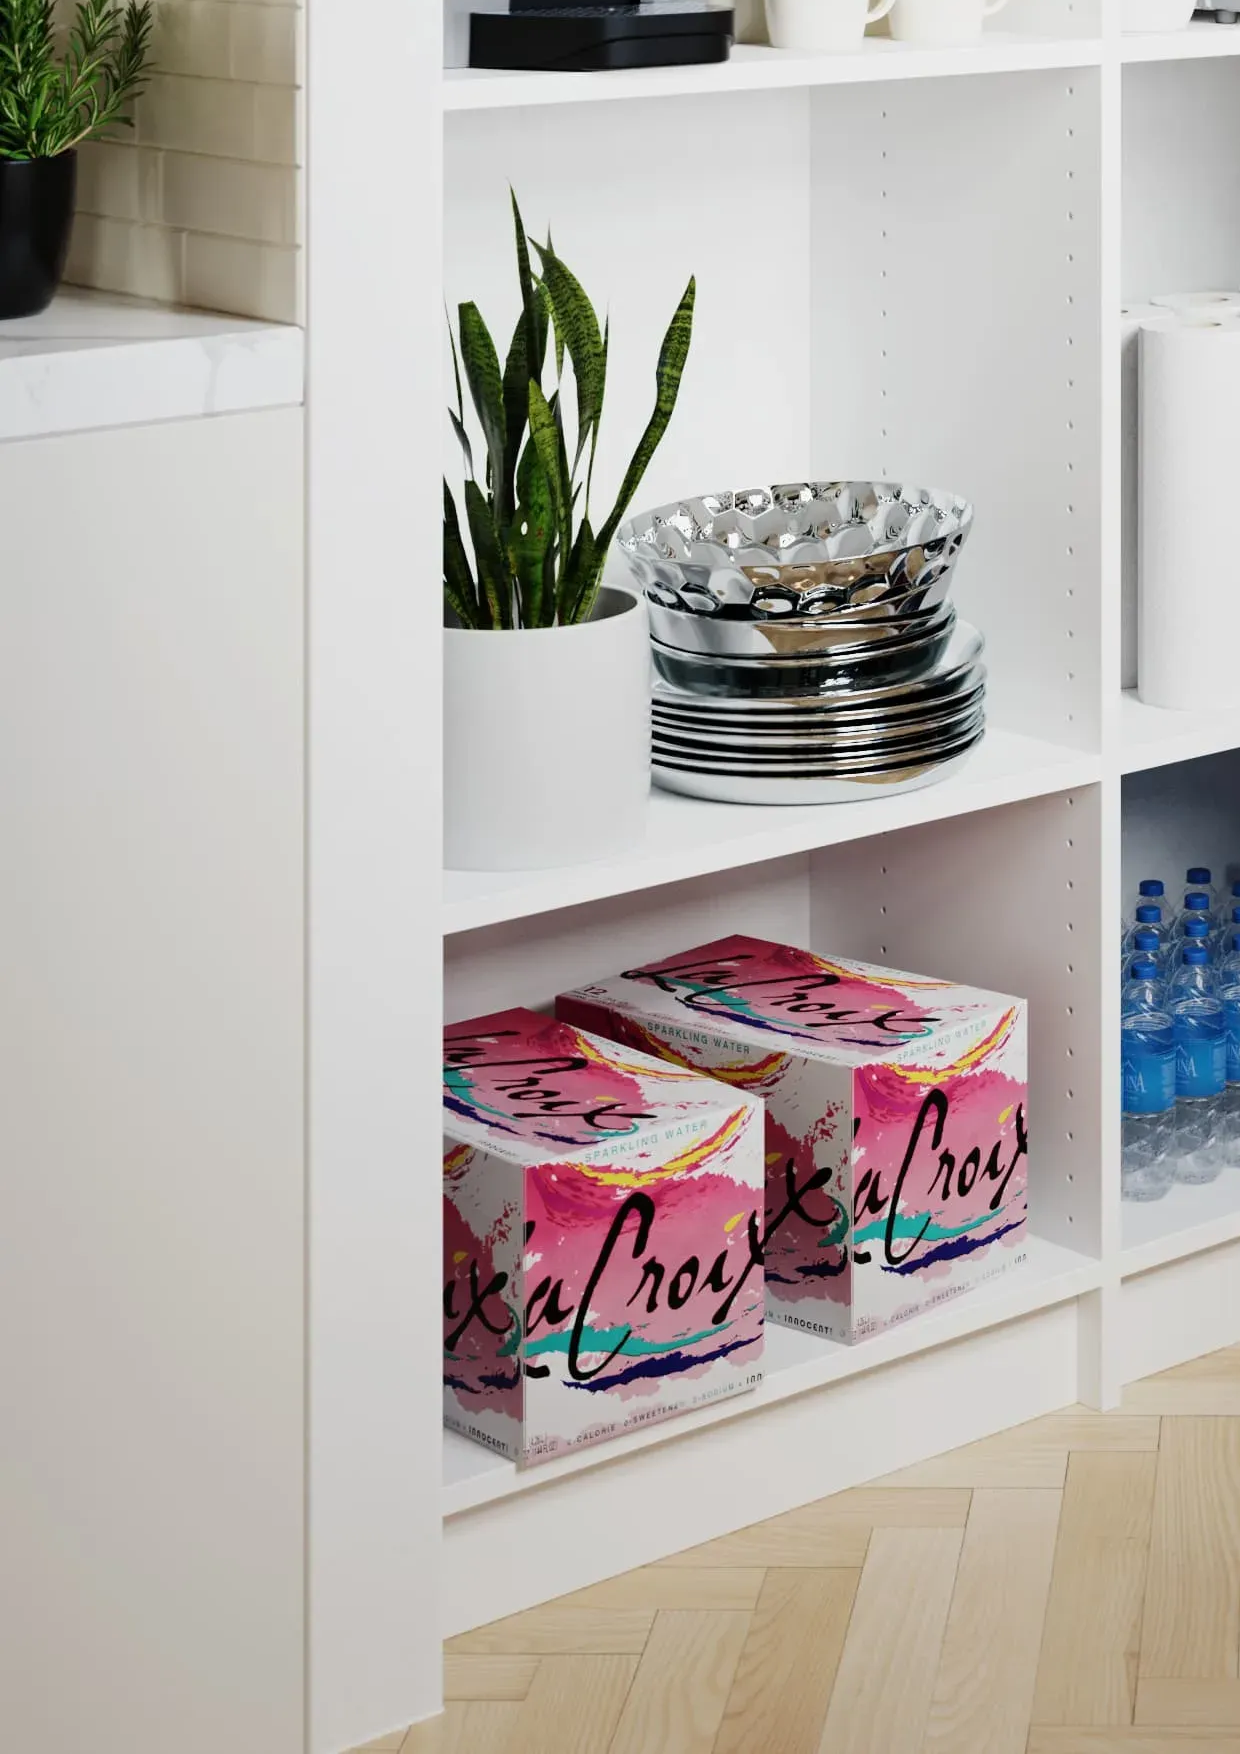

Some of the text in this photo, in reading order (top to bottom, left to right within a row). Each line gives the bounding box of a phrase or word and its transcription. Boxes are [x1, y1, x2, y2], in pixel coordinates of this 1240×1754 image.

[647, 1022, 708, 1045] SPARKLING
[713, 1037, 751, 1054] WATER
[896, 1019, 988, 1063] SPARKLING WATER
[584, 1118, 708, 1163] SPARKLING WATER
